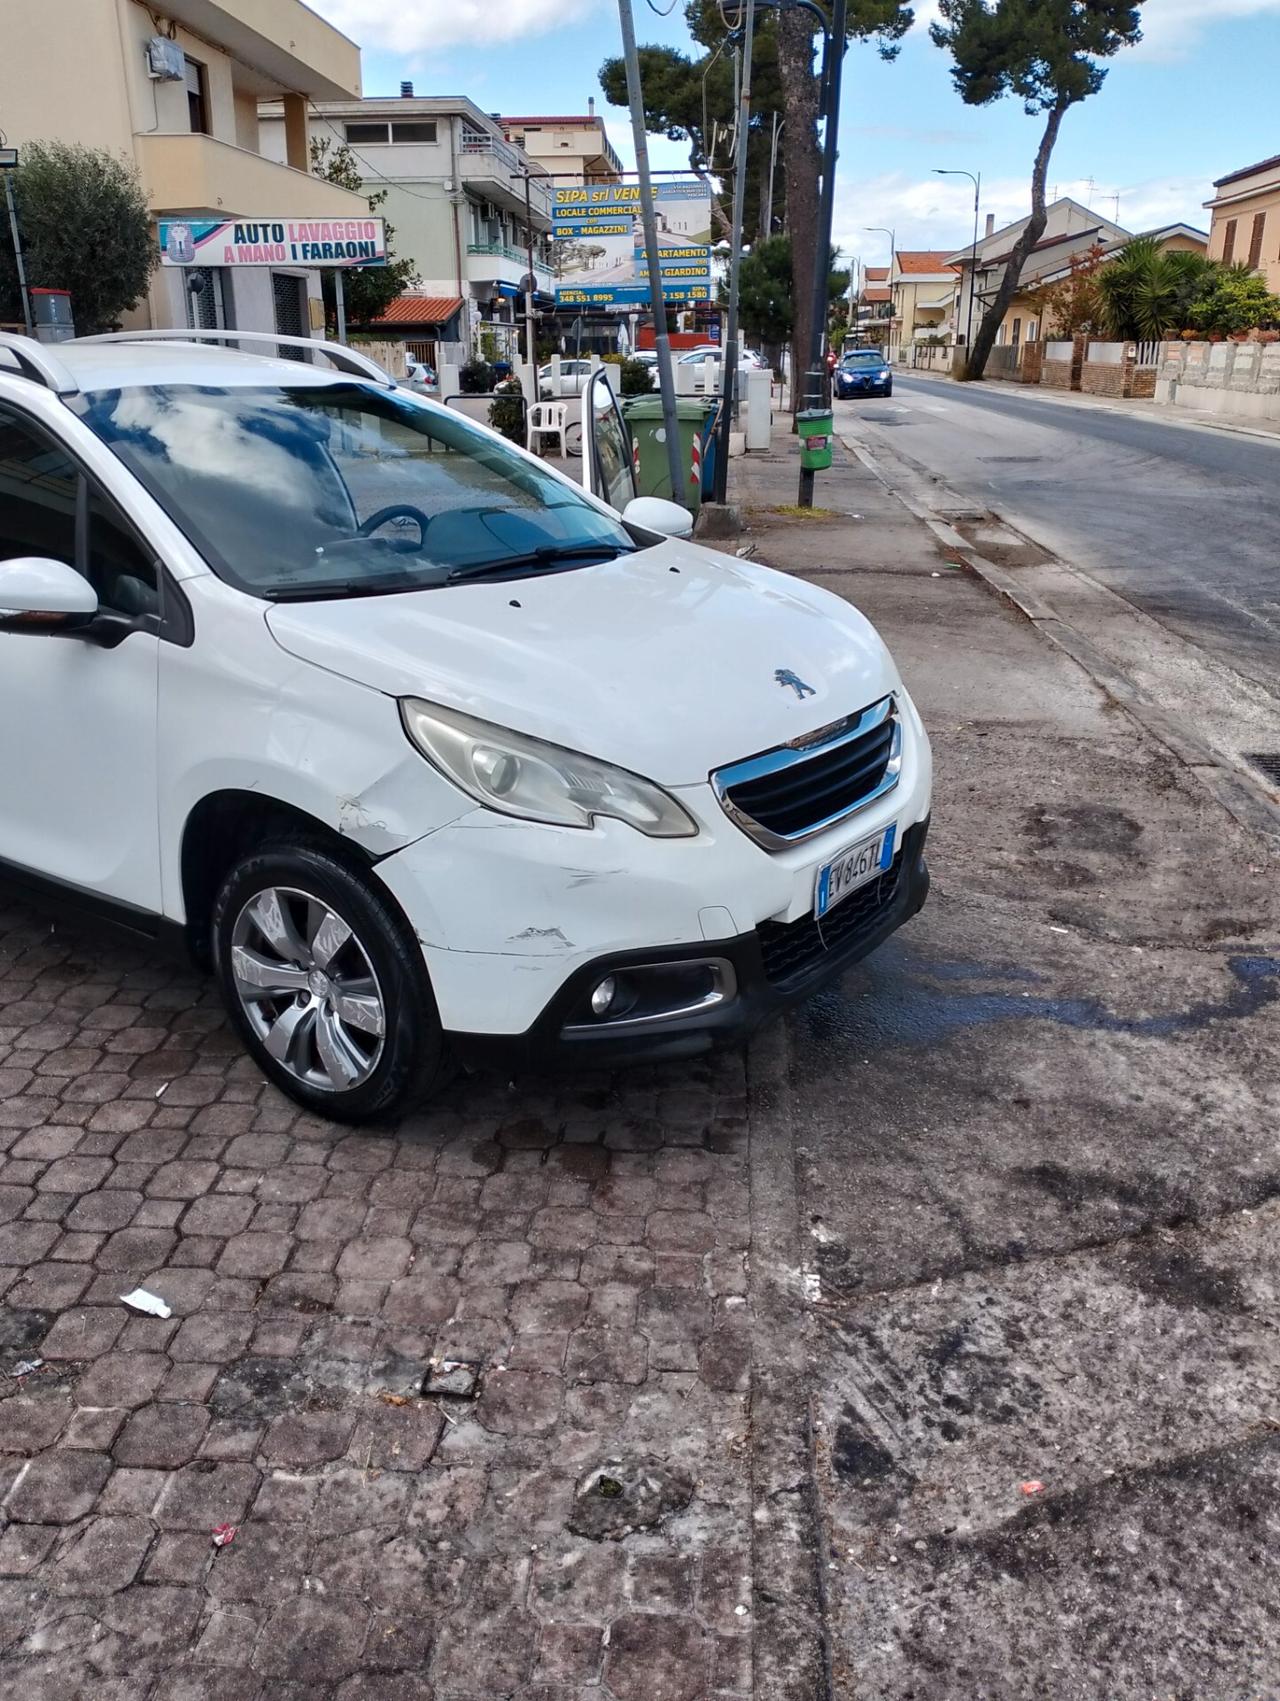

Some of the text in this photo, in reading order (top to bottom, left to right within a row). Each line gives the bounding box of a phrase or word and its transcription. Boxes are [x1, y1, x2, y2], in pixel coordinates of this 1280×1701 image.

[556, 190, 588, 203] SIPA
[592, 188, 609, 202] srl
[614, 186, 658, 200] VENE
[556, 205, 644, 217] LOCALE COMMERCIAL
[234, 221, 376, 244] AUTO LAVAGGIO
[556, 227, 574, 236] BOX
[581, 225, 628, 235] MAGAZZINI
[224, 240, 376, 263] A MANO I FARAONI
[641, 248, 708, 258] AARTAMENTO
[664, 267, 708, 276] GIARDINO
[559, 294, 614, 303] 348 551 8995
[687, 291, 708, 299] 1580
